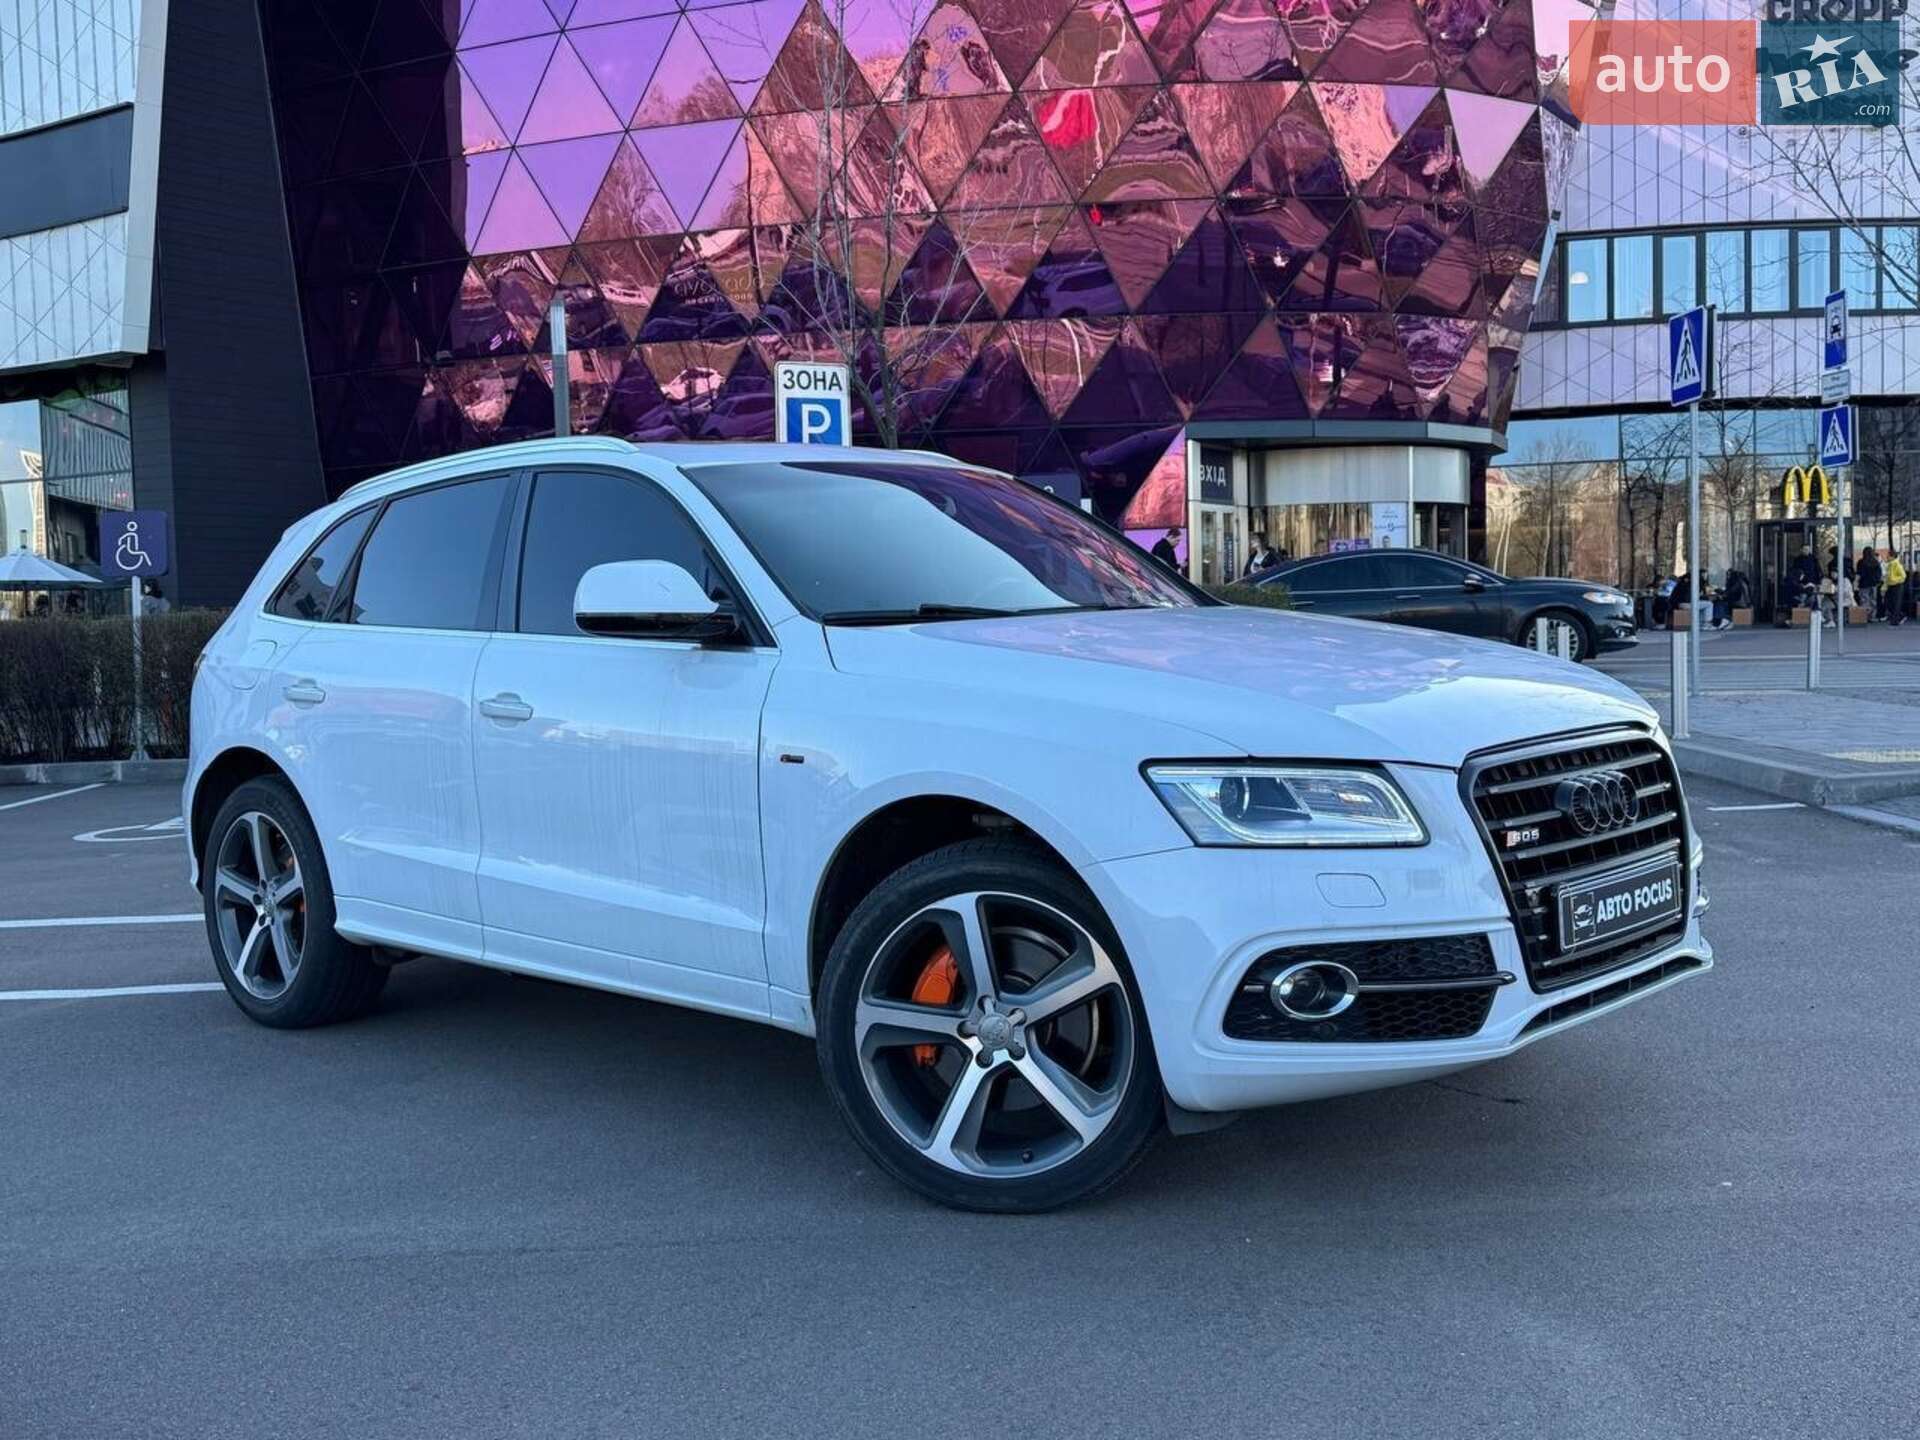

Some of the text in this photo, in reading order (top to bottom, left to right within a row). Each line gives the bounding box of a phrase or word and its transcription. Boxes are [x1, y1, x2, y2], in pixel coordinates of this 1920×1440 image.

[783, 369, 843, 391] ЗОНА
[802, 404, 831, 443] P
[1597, 878, 1673, 923] АВТО FOCUS
